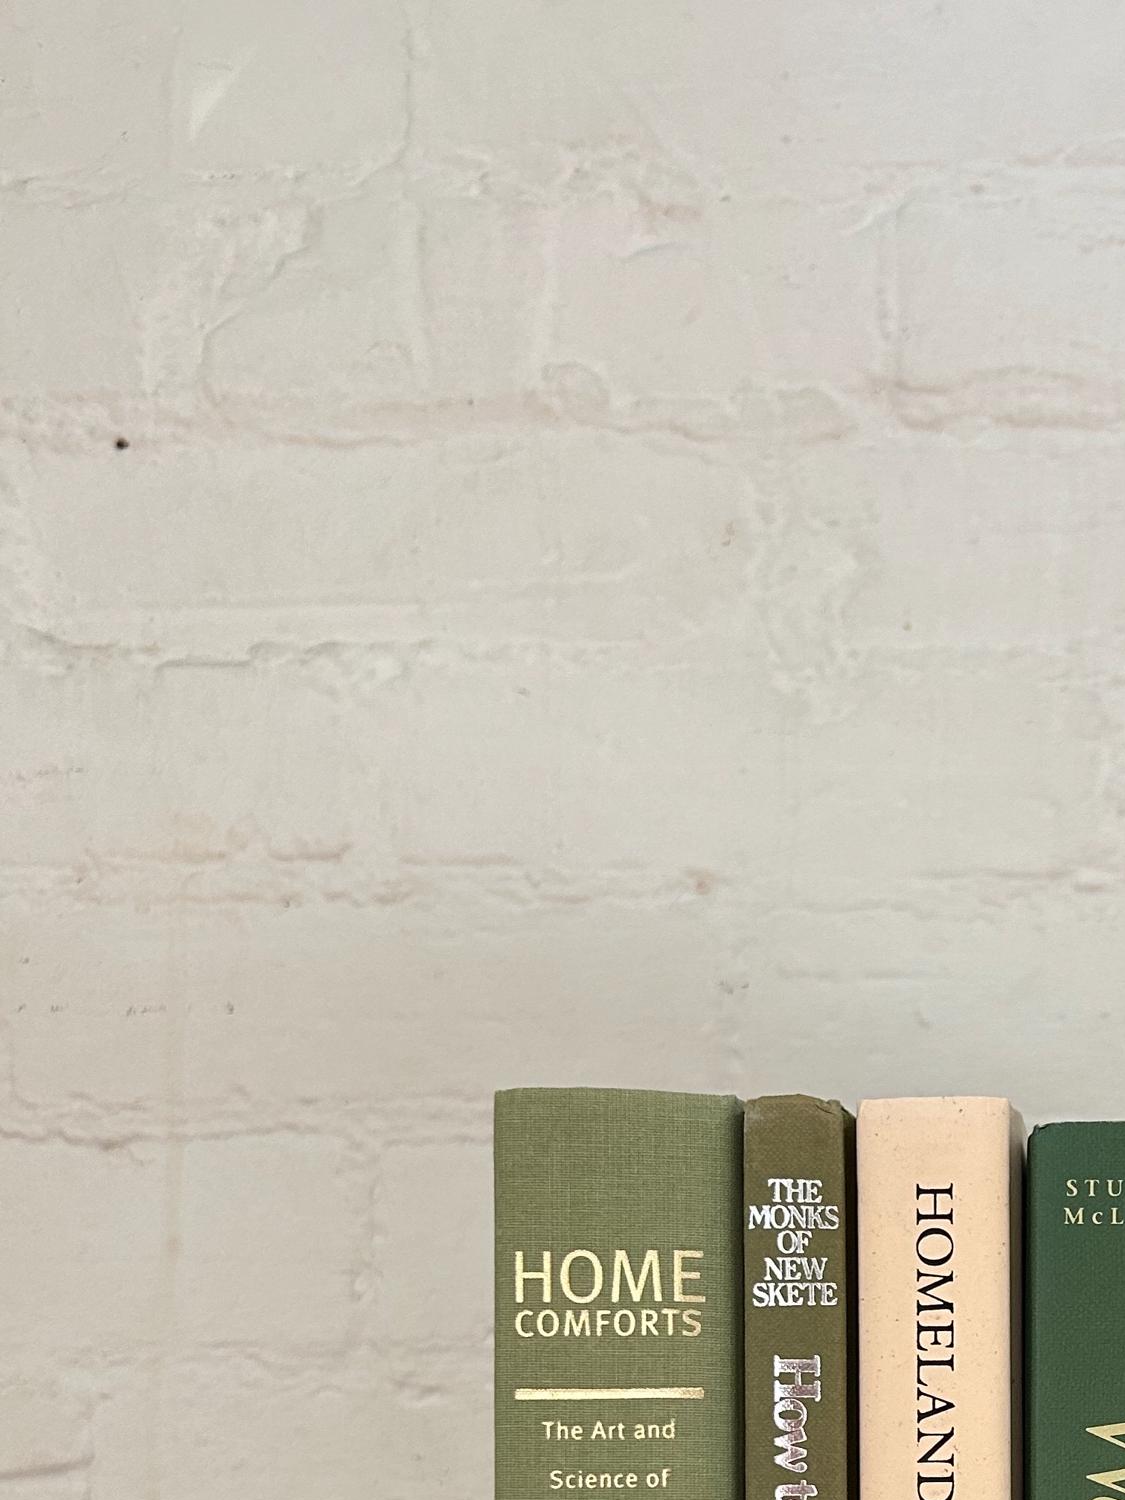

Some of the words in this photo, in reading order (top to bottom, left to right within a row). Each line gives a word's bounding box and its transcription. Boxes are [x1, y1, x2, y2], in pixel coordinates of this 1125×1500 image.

[767, 1178, 823, 1204] THE
[748, 1204, 840, 1230] MONKS
[776, 1230, 813, 1254] OF
[514, 1249, 706, 1304] HOME
[763, 1257, 829, 1281] NEW
[752, 1282, 839, 1308] SKETE
[514, 1308, 703, 1338] COMFORTS
[772, 1354, 822, 1474] How
[542, 1421, 583, 1440] The
[591, 1421, 625, 1440] Art
[633, 1418, 676, 1439] and
[550, 1469, 638, 1490] Science
[646, 1467, 672, 1489] of
